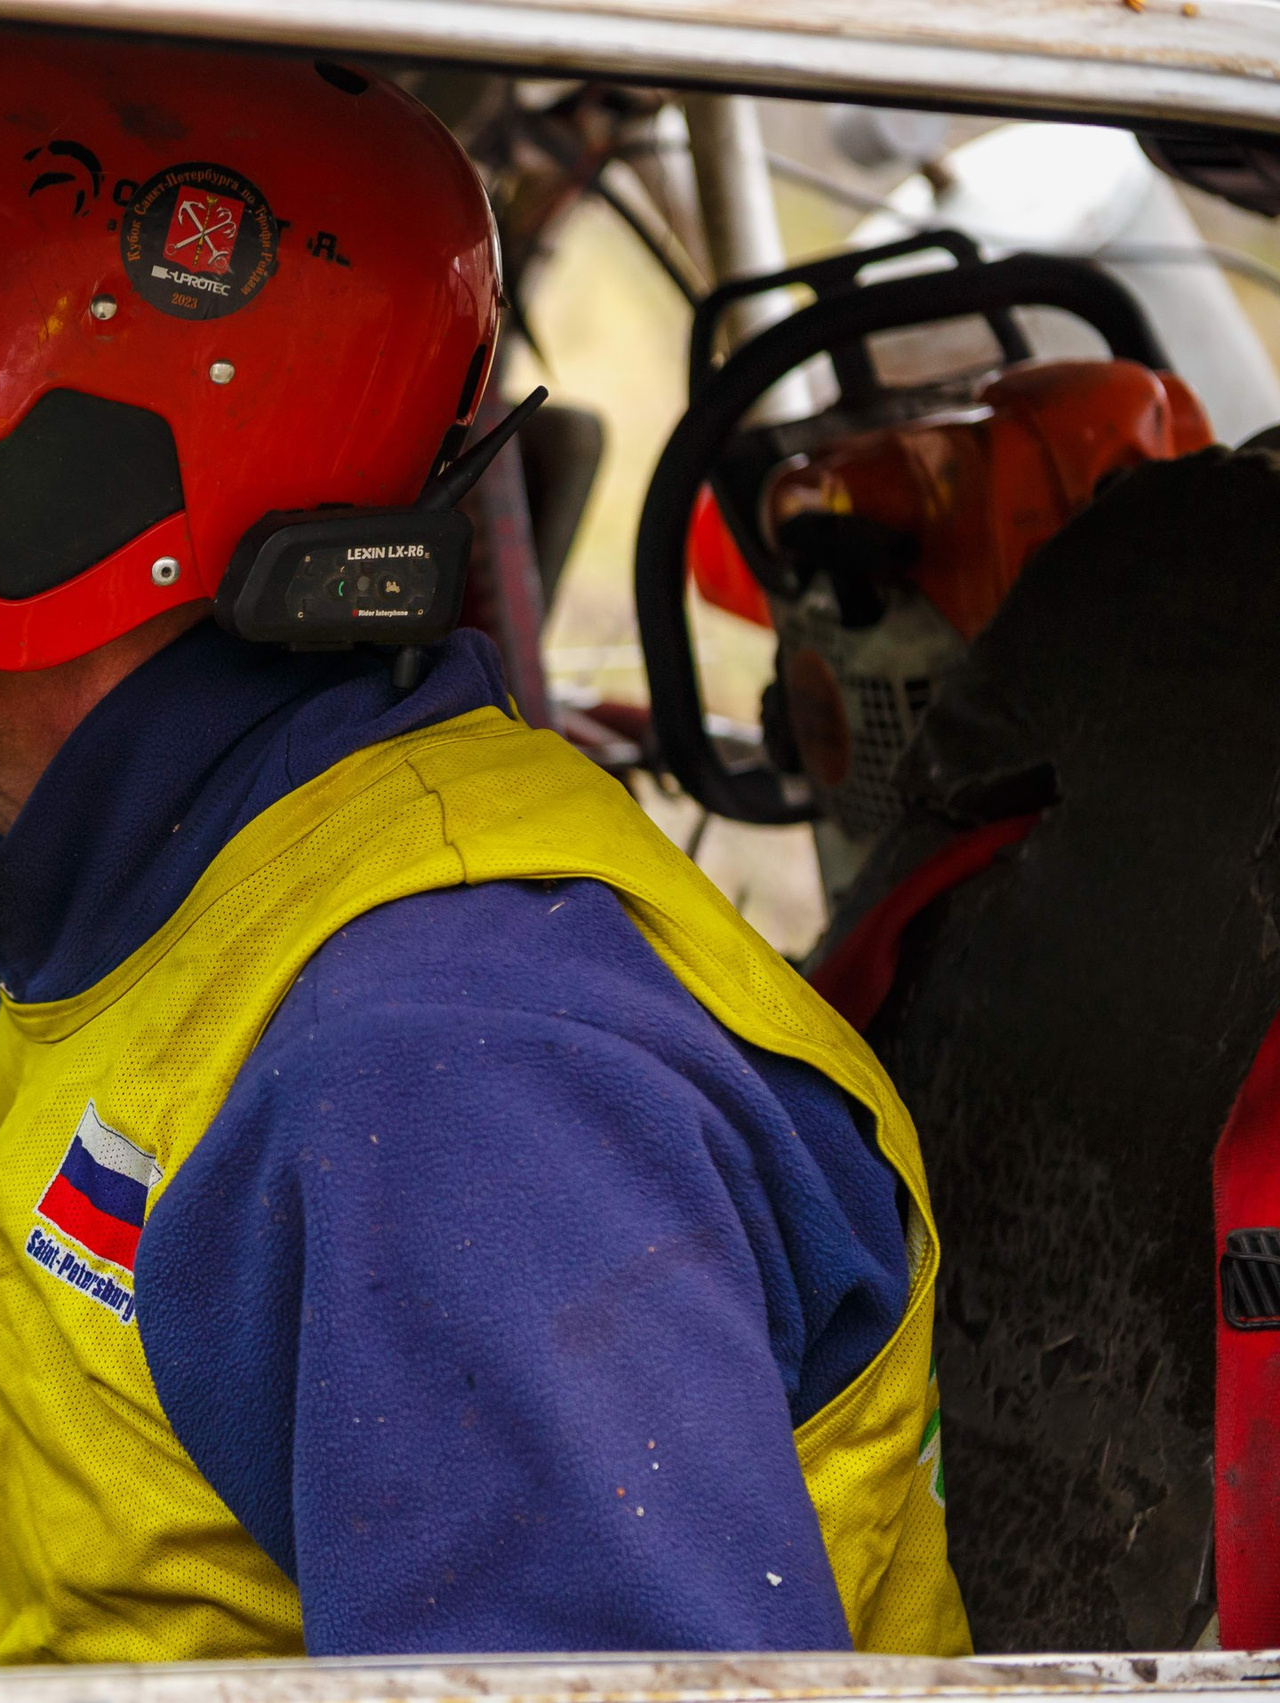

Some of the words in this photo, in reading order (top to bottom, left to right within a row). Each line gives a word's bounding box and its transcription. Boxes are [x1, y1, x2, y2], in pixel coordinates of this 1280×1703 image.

[126, 220, 141, 262] Кубок
[134, 168, 240, 215] Санкт-Петербурга
[241, 188, 256, 204] по
[161, 268, 231, 297] SUPROTEC
[171, 292, 198, 309] 2023
[347, 547, 386, 560] LEXIN
[388, 545, 424, 558] LX-R6
[375, 609, 408, 617] Interphone
